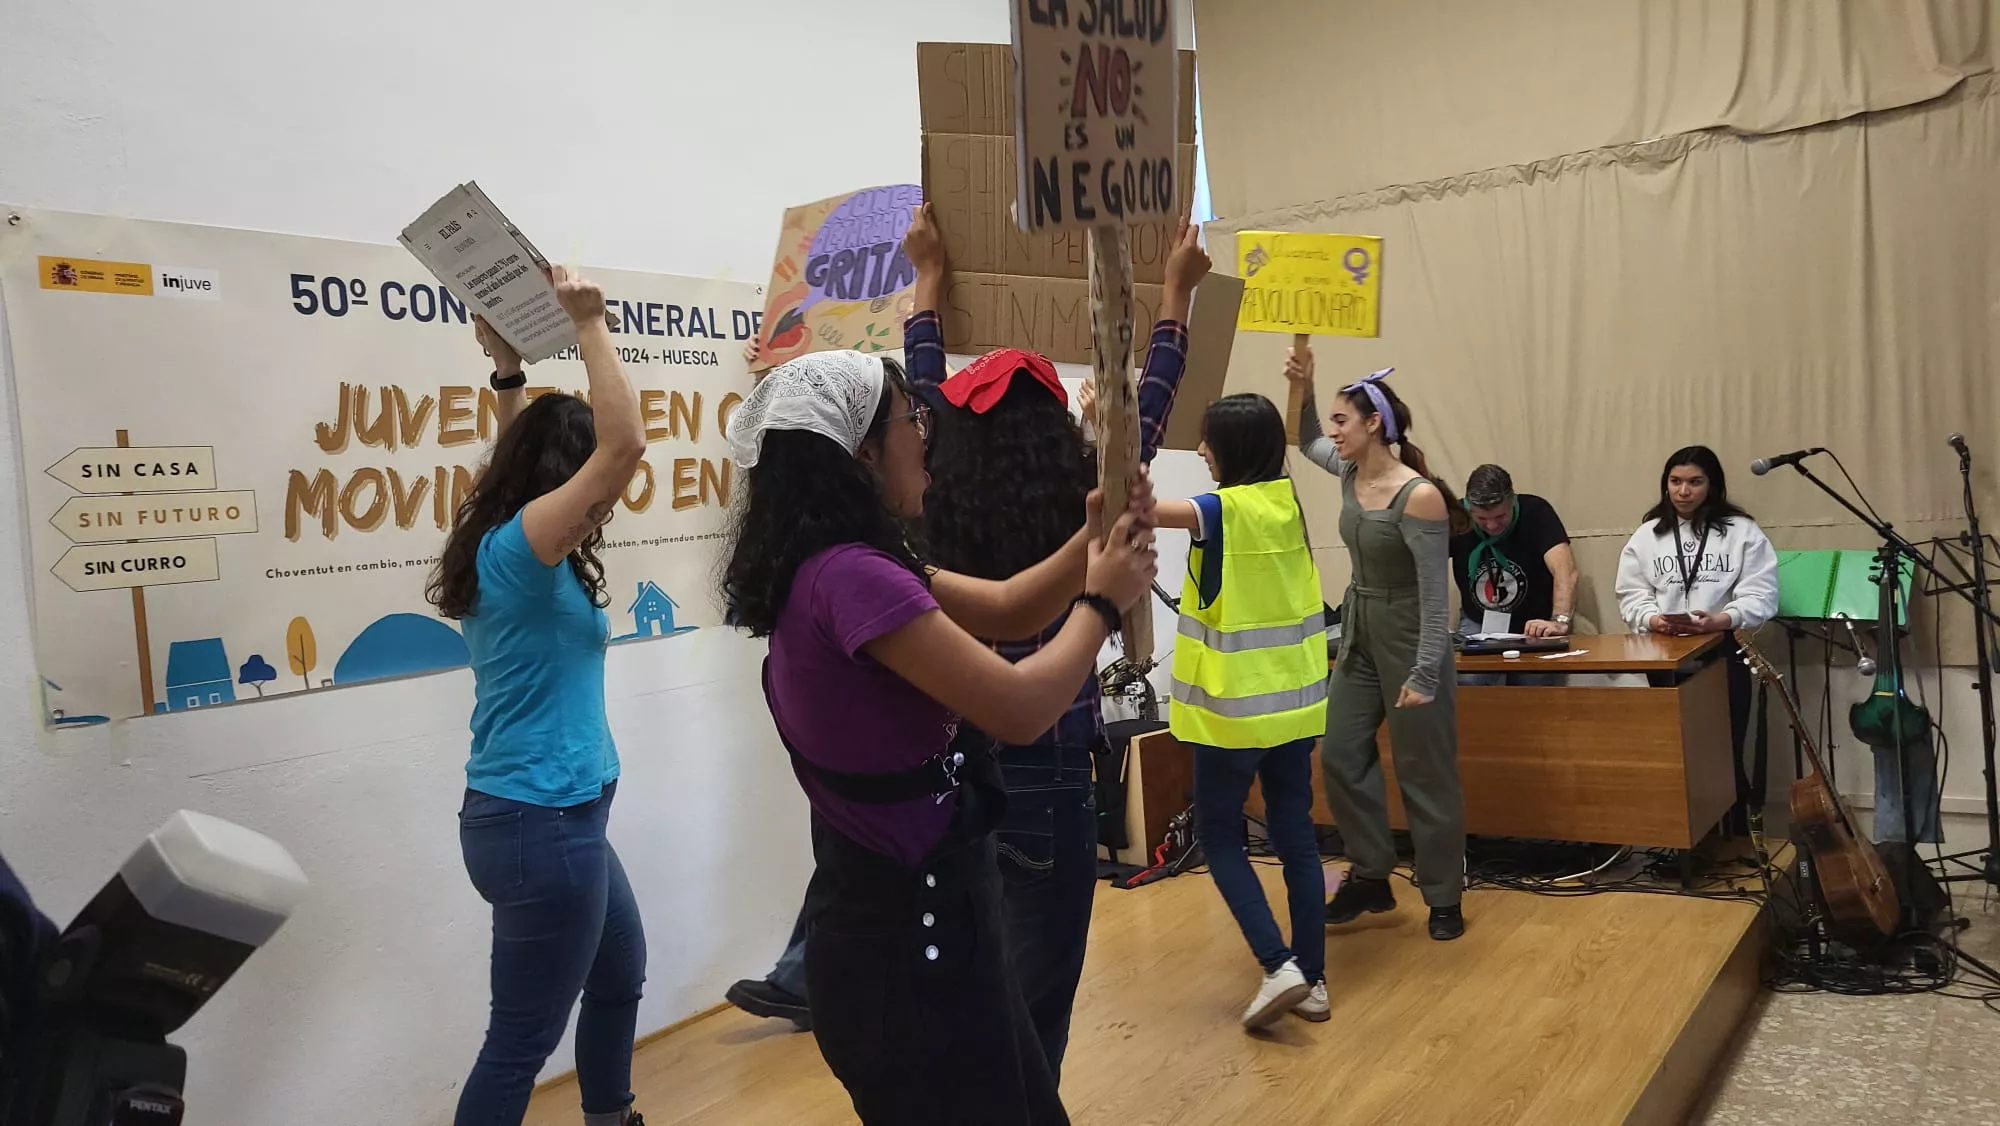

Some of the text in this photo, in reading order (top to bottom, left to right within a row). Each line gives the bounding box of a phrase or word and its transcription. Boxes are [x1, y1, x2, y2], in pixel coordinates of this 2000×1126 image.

[1070, 41, 1132, 119] NO
[1064, 122, 1135, 151] ES UN
[1032, 155, 1173, 227] NEGOCIO
[162, 273, 212, 292] injuve
[804, 241, 914, 300] GRITA
[290, 273, 369, 318] 50º
[605, 299, 726, 340] ENERAL
[662, 349, 719, 366] HUESCA
[81, 461, 199, 479] SIN CASA
[672, 457, 733, 512] EN
[79, 505, 241, 529] SIN FUTURO
[84, 555, 187, 576] SIN CURRO
[265, 564, 335, 579] Choventut
[337, 564, 352, 573] en
[355, 558, 402, 571] cambio,
[129, 1099, 172, 1115] PENTAX
